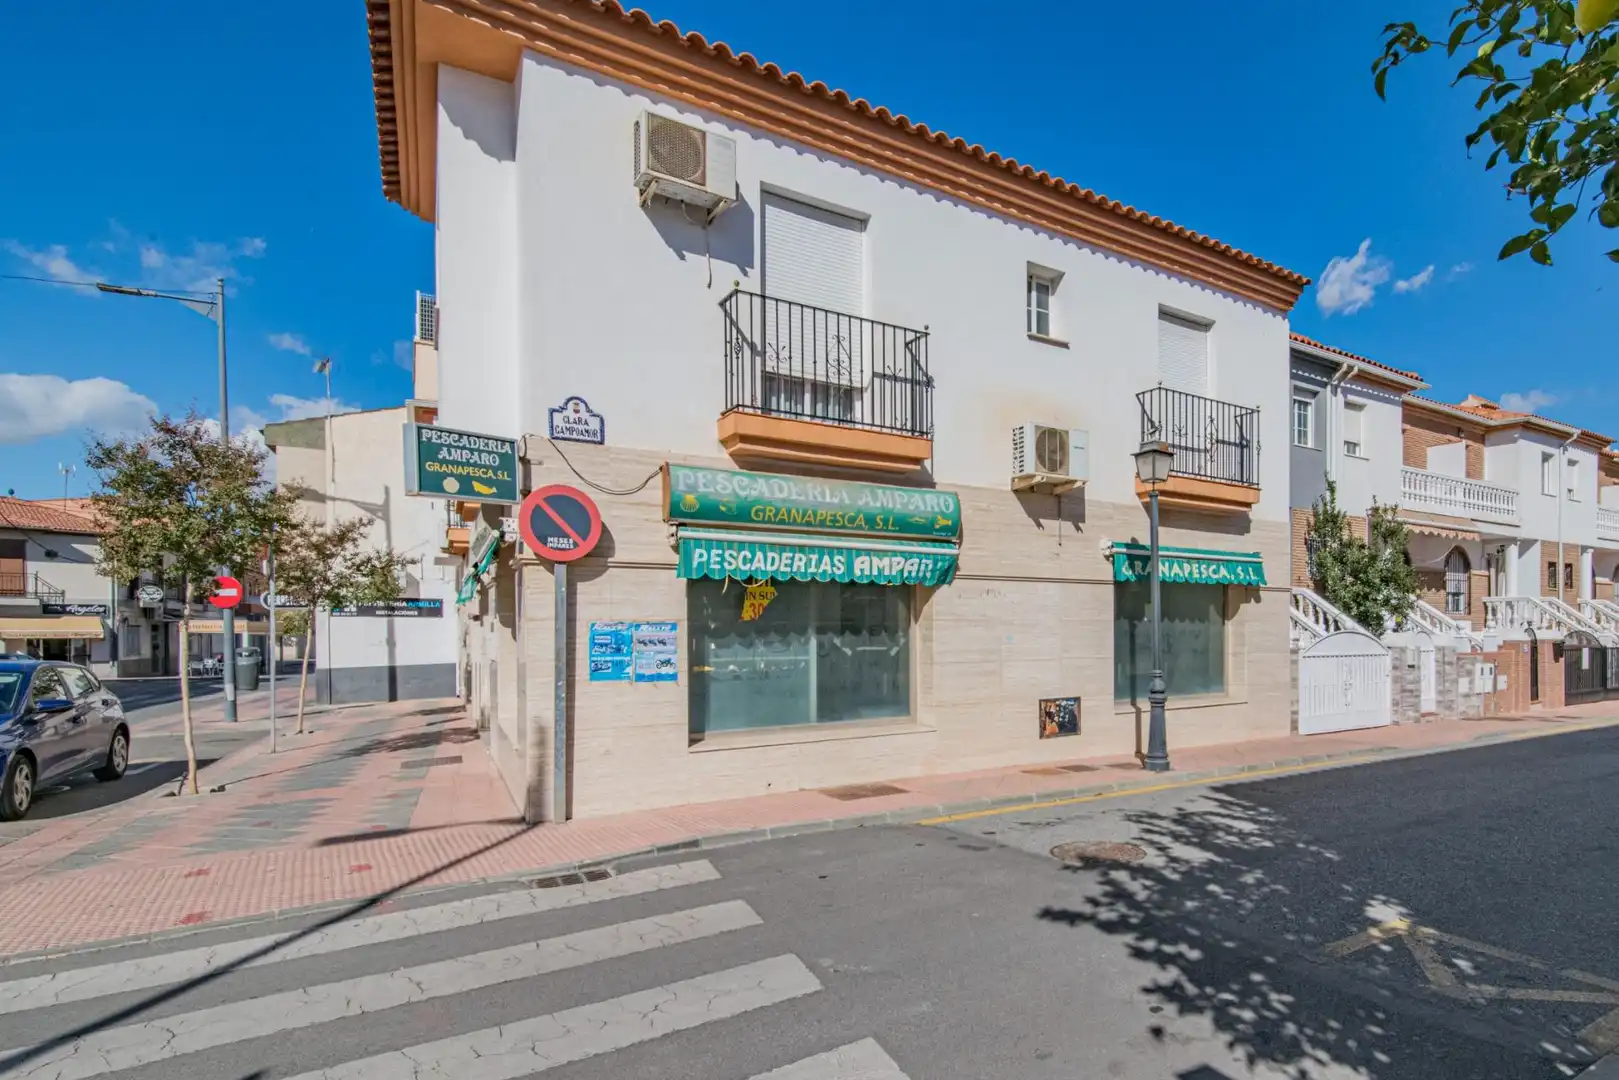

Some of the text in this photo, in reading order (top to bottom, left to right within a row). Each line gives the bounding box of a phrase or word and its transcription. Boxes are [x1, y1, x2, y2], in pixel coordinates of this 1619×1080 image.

[554, 424, 599, 440] CAMPOAMOR
[563, 415, 590, 427] CLARA
[420, 428, 512, 454] PESCADERIA
[437, 446, 499, 466] AMPARO
[675, 468, 955, 515] PESCADERIA AMPARO
[691, 548, 942, 579] PESCADERIAS AMPAR
